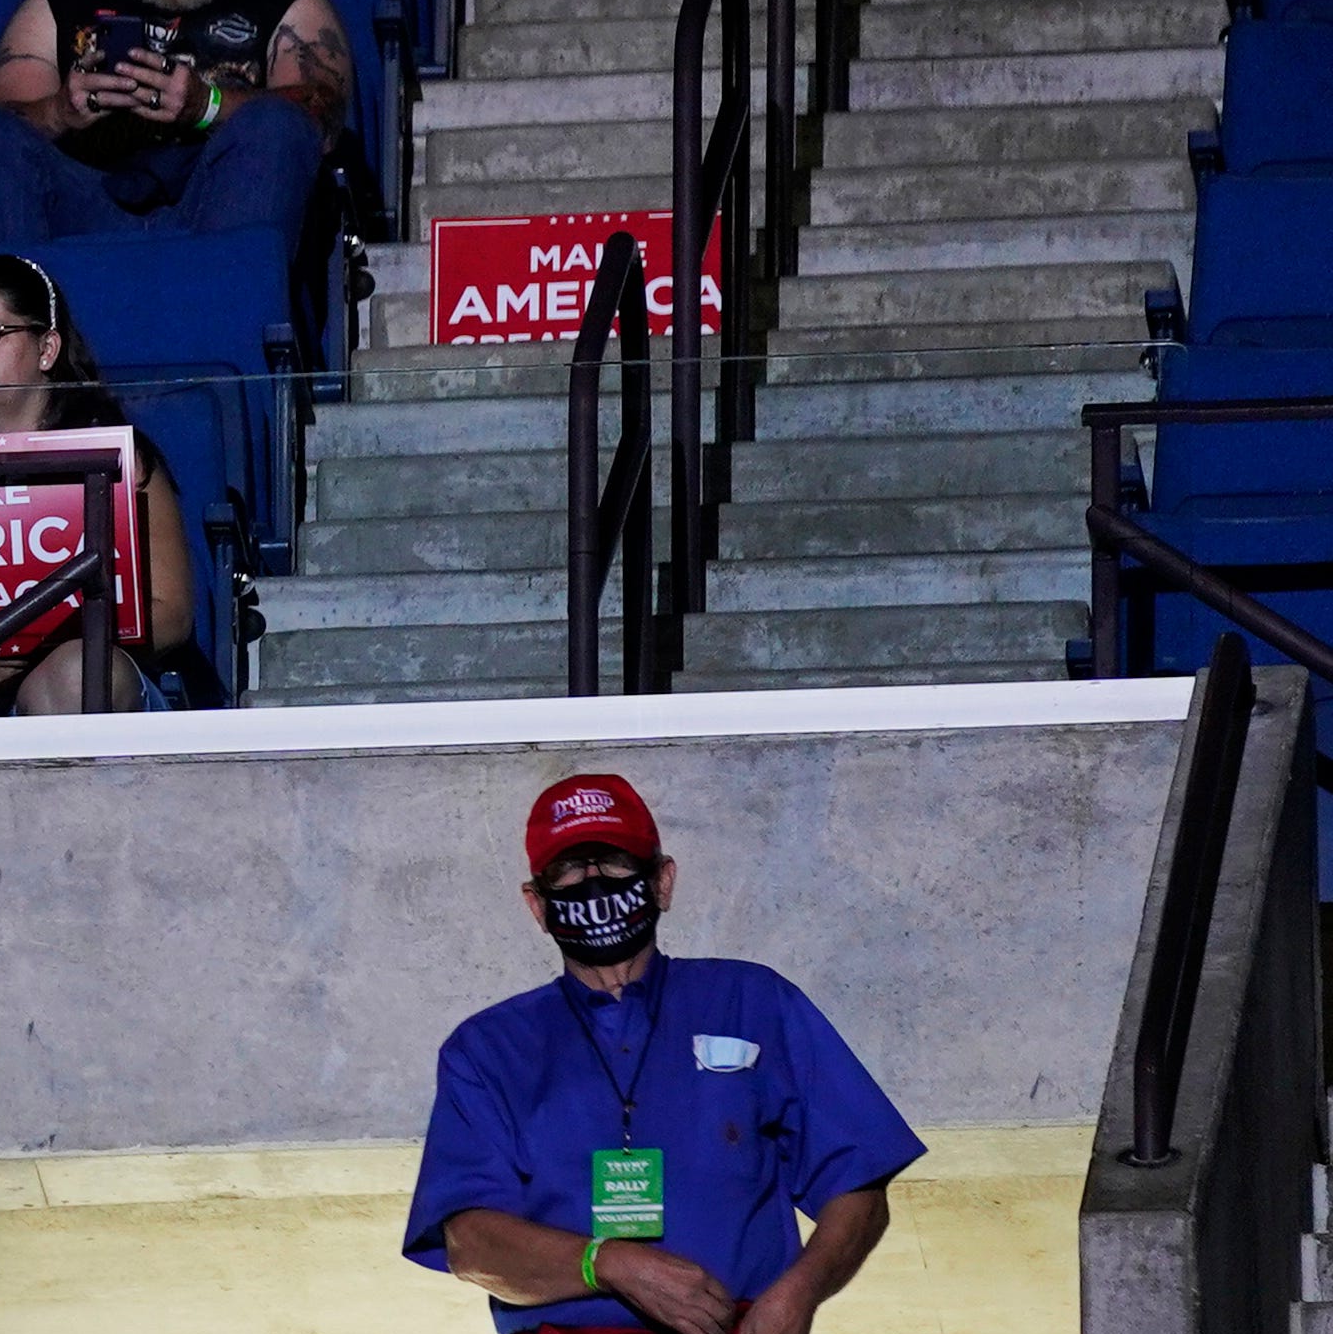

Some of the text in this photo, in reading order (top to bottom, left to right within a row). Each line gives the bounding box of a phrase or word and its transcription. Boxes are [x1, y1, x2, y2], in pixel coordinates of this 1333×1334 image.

[530, 241, 647, 273] MAE
[448, 274, 721, 325] AMECA
[604, 1180, 650, 1193] RALLY
[596, 1213, 659, 1223] VOLUNTEER
